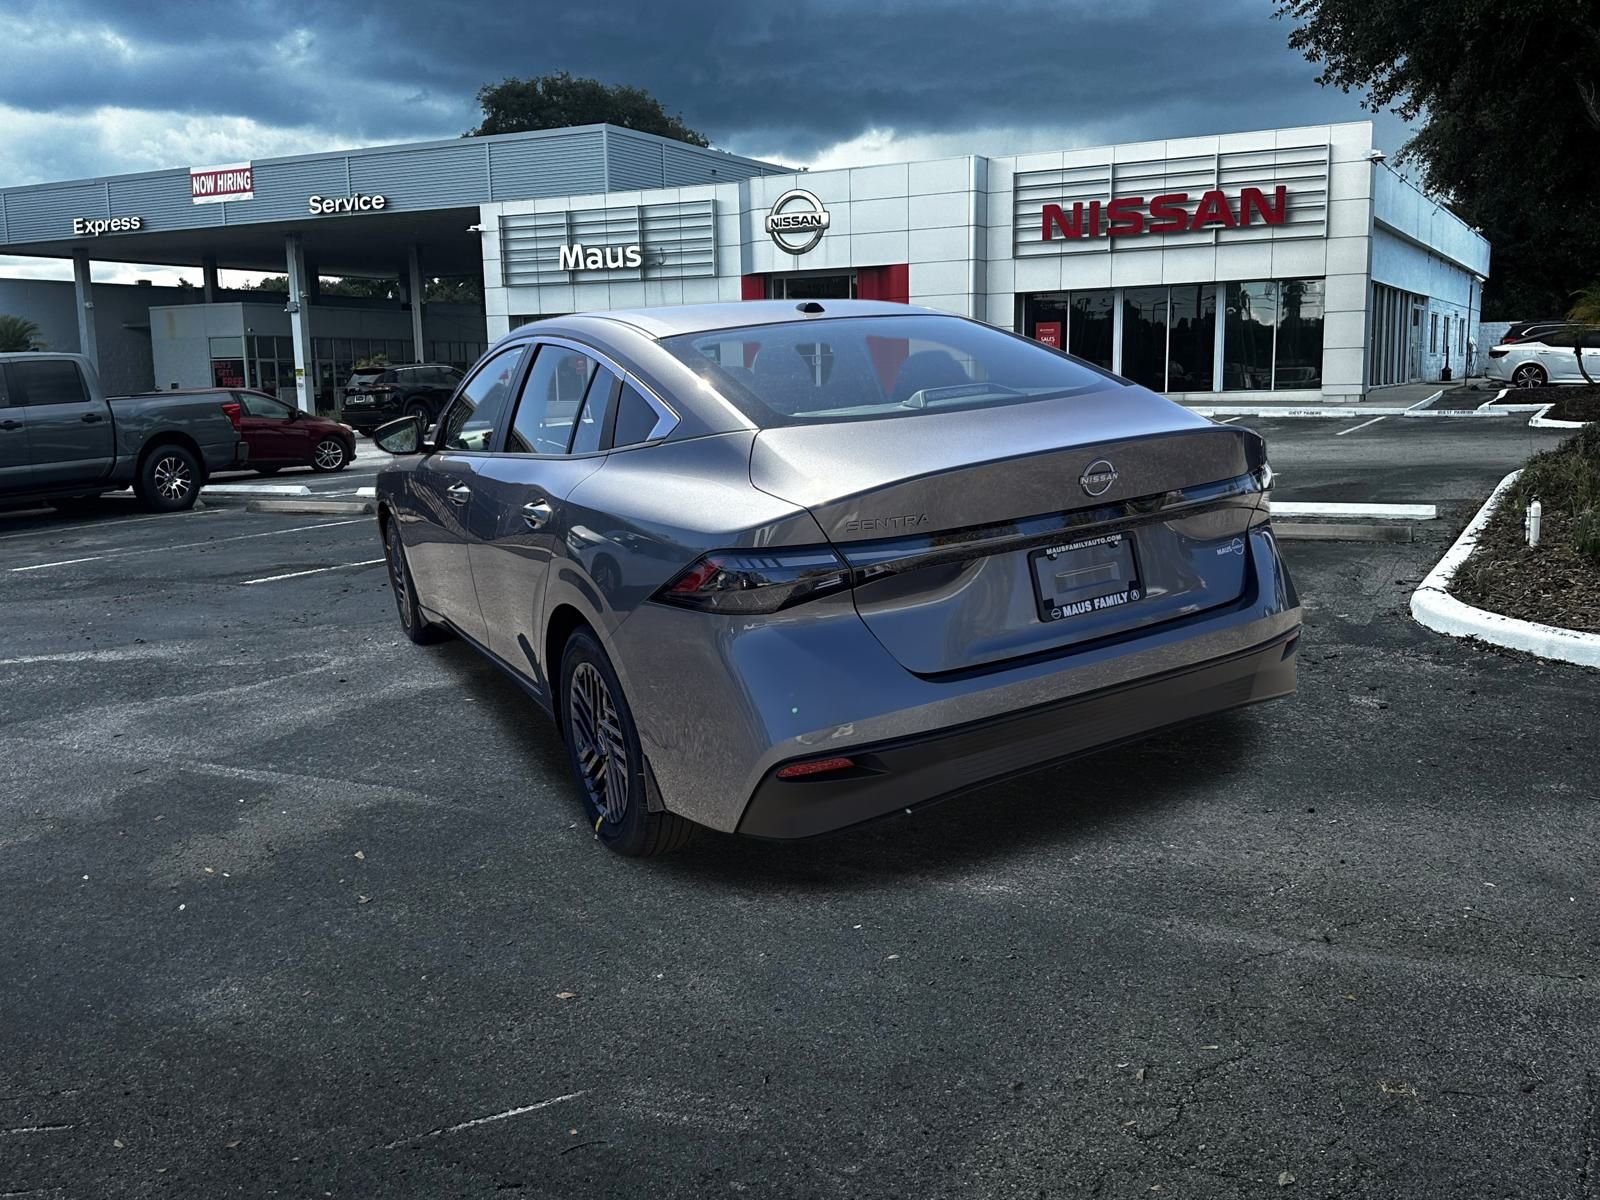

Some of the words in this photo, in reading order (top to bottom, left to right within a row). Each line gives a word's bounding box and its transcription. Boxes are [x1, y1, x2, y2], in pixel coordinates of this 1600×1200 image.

[192, 175, 215, 194] NOW
[217, 171, 251, 192] HIRING
[309, 193, 385, 214] Service
[1042, 185, 1287, 240] NISSAN
[73, 216, 141, 236] Express
[770, 214, 822, 228] NISSAN
[560, 243, 642, 270] Maus
[1081, 472, 1119, 484] NISSAN
[845, 513, 929, 533] SENTRA
[1046, 534, 1122, 555] MAUSFAMILYAUTO.COM
[1216, 545, 1232, 555] MAUS
[1062, 600, 1092, 617] MAUS
[1094, 591, 1129, 609] FAMILY
